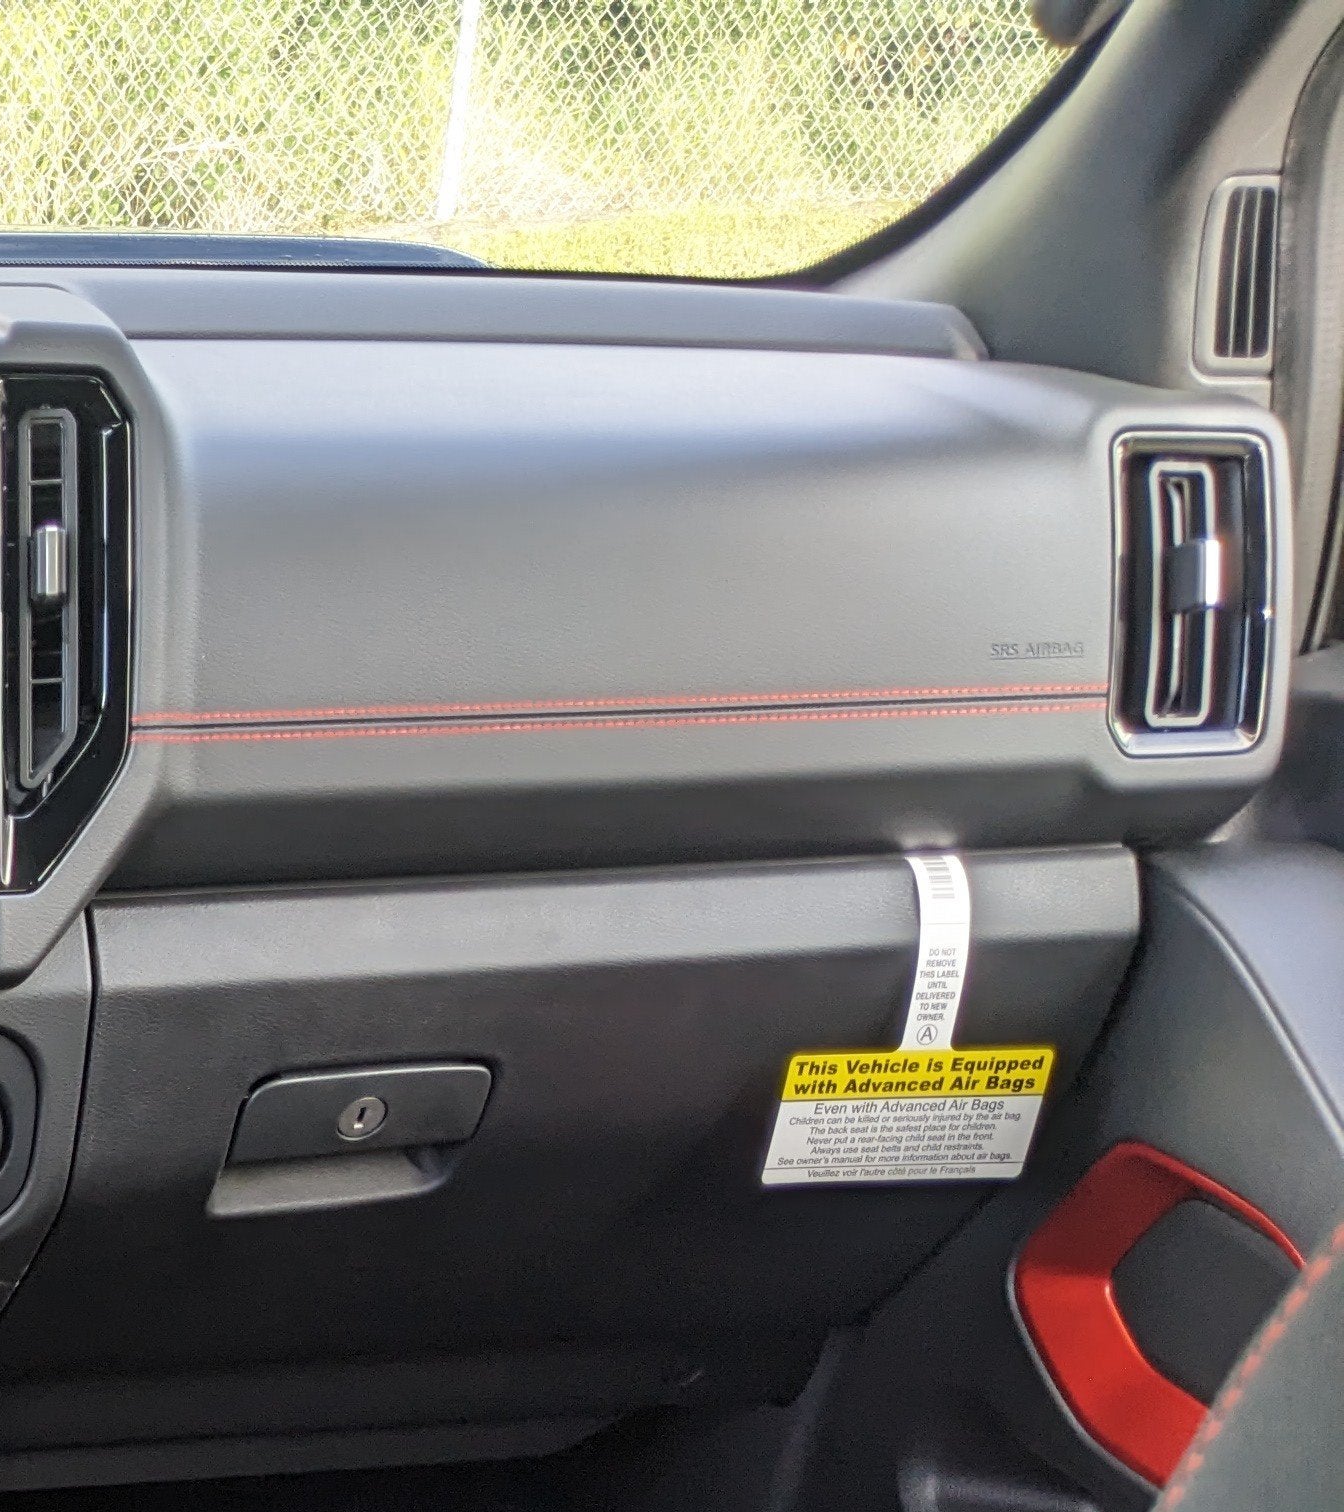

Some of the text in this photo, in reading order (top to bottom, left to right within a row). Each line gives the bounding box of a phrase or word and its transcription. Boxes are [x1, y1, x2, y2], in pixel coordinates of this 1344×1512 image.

[796, 1056, 1045, 1076] This Vehicle is Equipped
[794, 1076, 1036, 1095] with Advanced Air Bags
[814, 1098, 1005, 1115] Even with Advanced Air Bags
